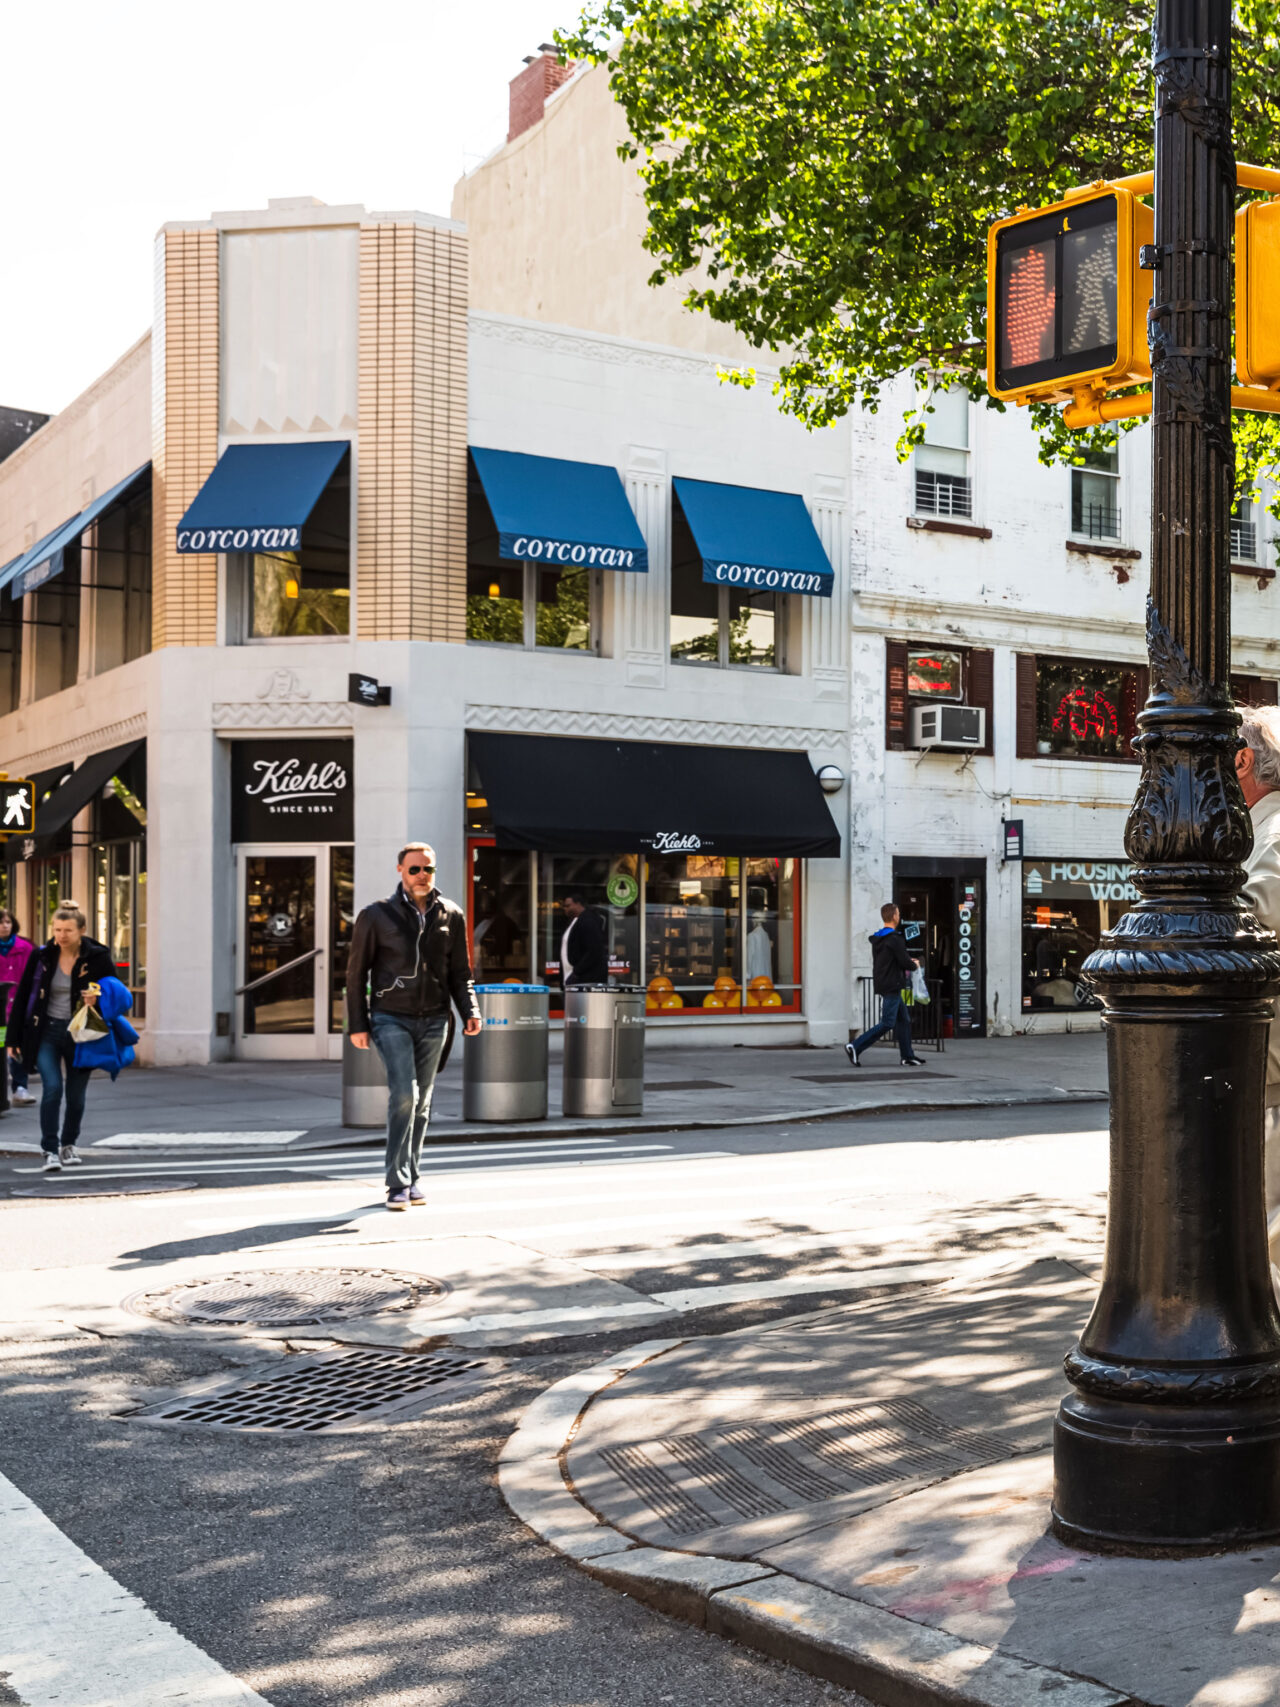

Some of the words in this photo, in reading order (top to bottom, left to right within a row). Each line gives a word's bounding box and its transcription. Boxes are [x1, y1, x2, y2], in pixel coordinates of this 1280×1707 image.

[177, 528, 299, 549] corcoran
[513, 536, 635, 568] corcoran
[715, 563, 822, 592] corcoran
[245, 758, 347, 795] Kiehl's
[269, 805, 303, 813] SINCE
[307, 805, 334, 813] 1851
[652, 832, 702, 849] Kiehl's
[1089, 883, 1141, 900] WOR
